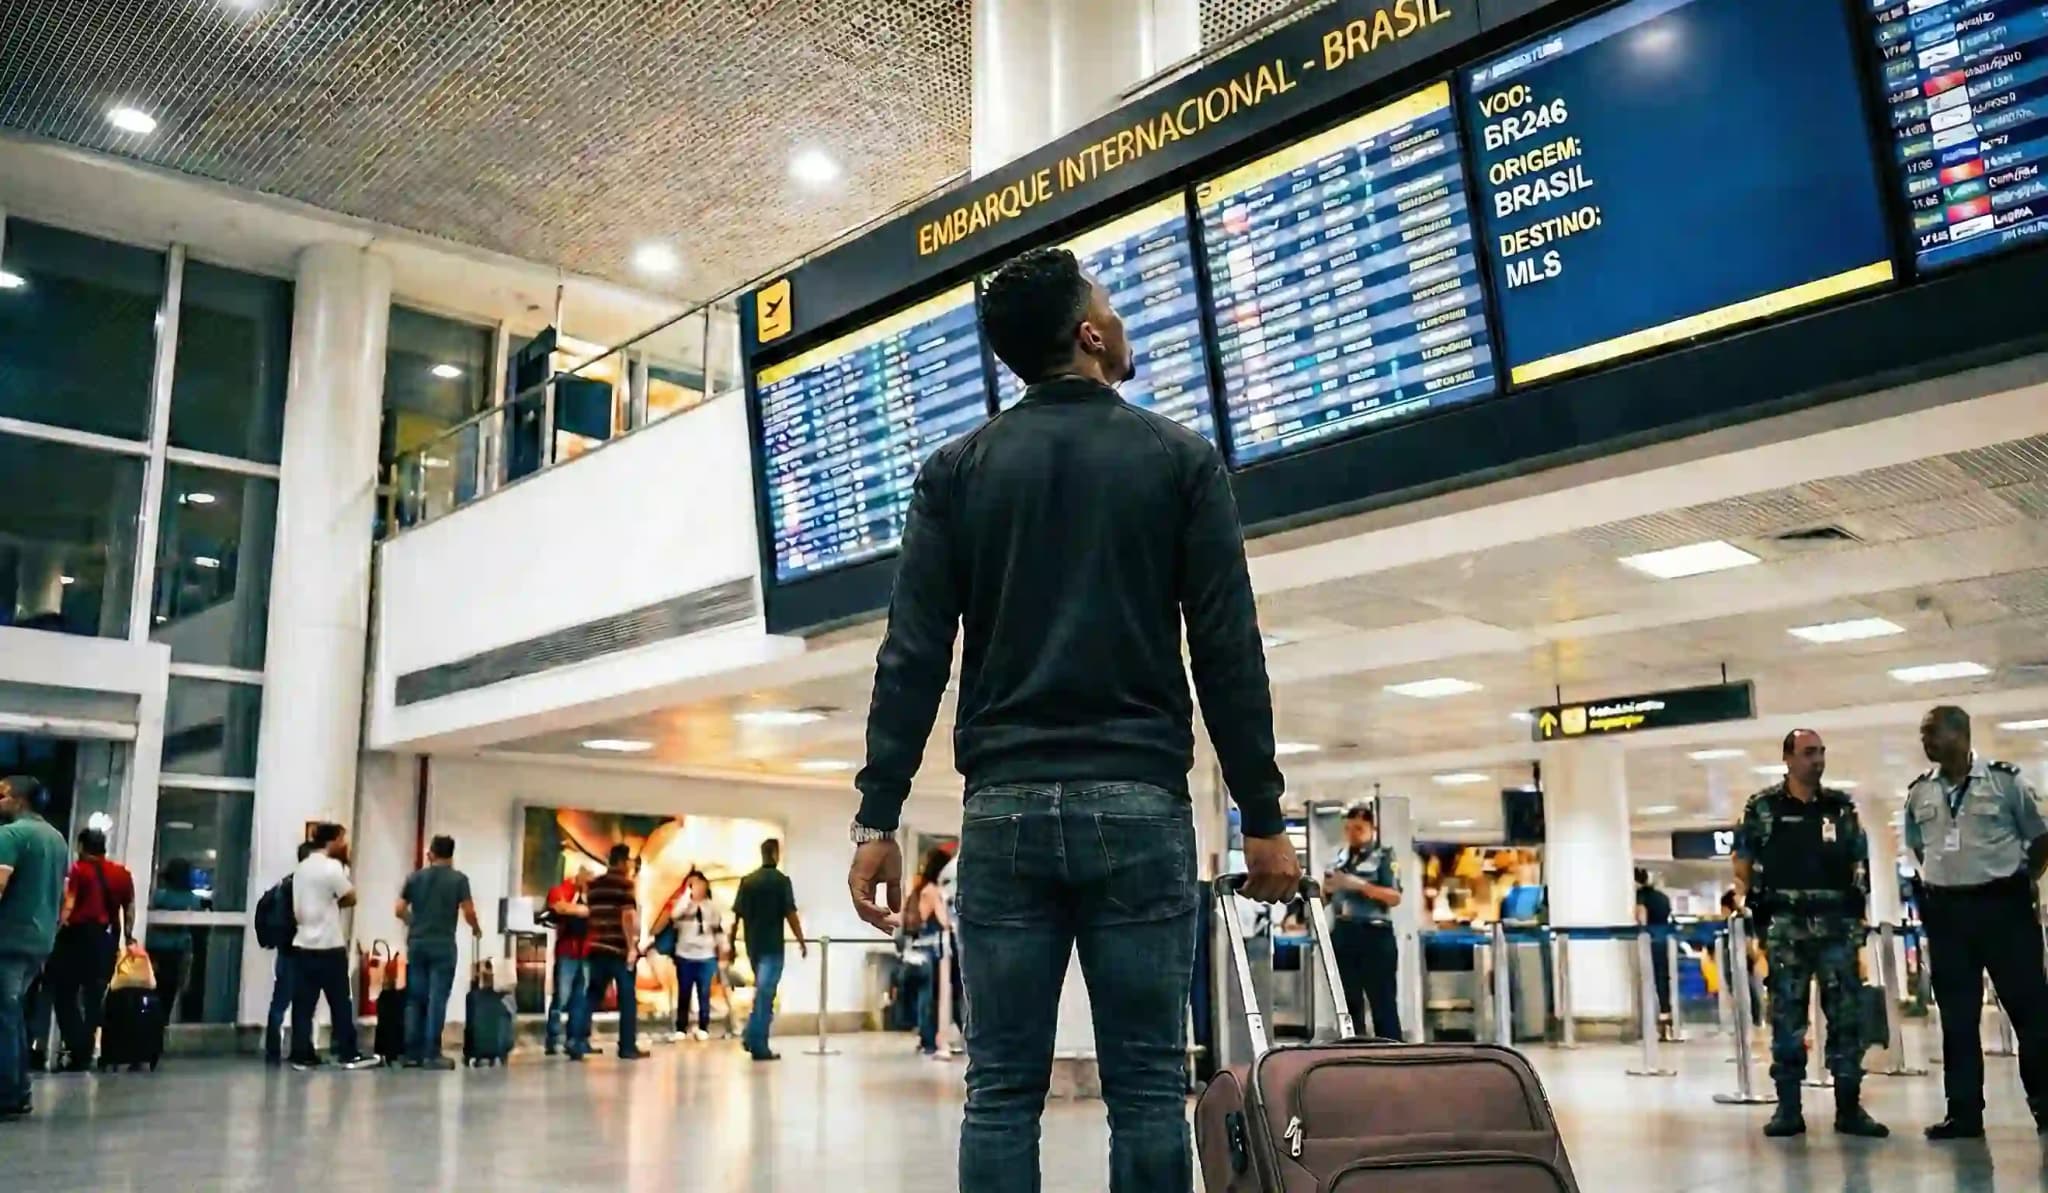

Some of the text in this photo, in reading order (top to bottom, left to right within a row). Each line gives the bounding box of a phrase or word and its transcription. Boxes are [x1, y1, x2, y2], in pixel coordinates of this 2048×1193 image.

[1479, 85, 1533, 118] VOO:
[919, 168, 1053, 255] EMBARQUE
[1058, 59, 1297, 192] INTERNACIONAL
[1322, 0, 1452, 71] BRASIL
[1489, 136, 1582, 185] ORIGEM:
[1494, 164, 1593, 218] BRASIL
[1499, 206, 1601, 257] DESTINO:
[1505, 250, 1562, 288] MLS
